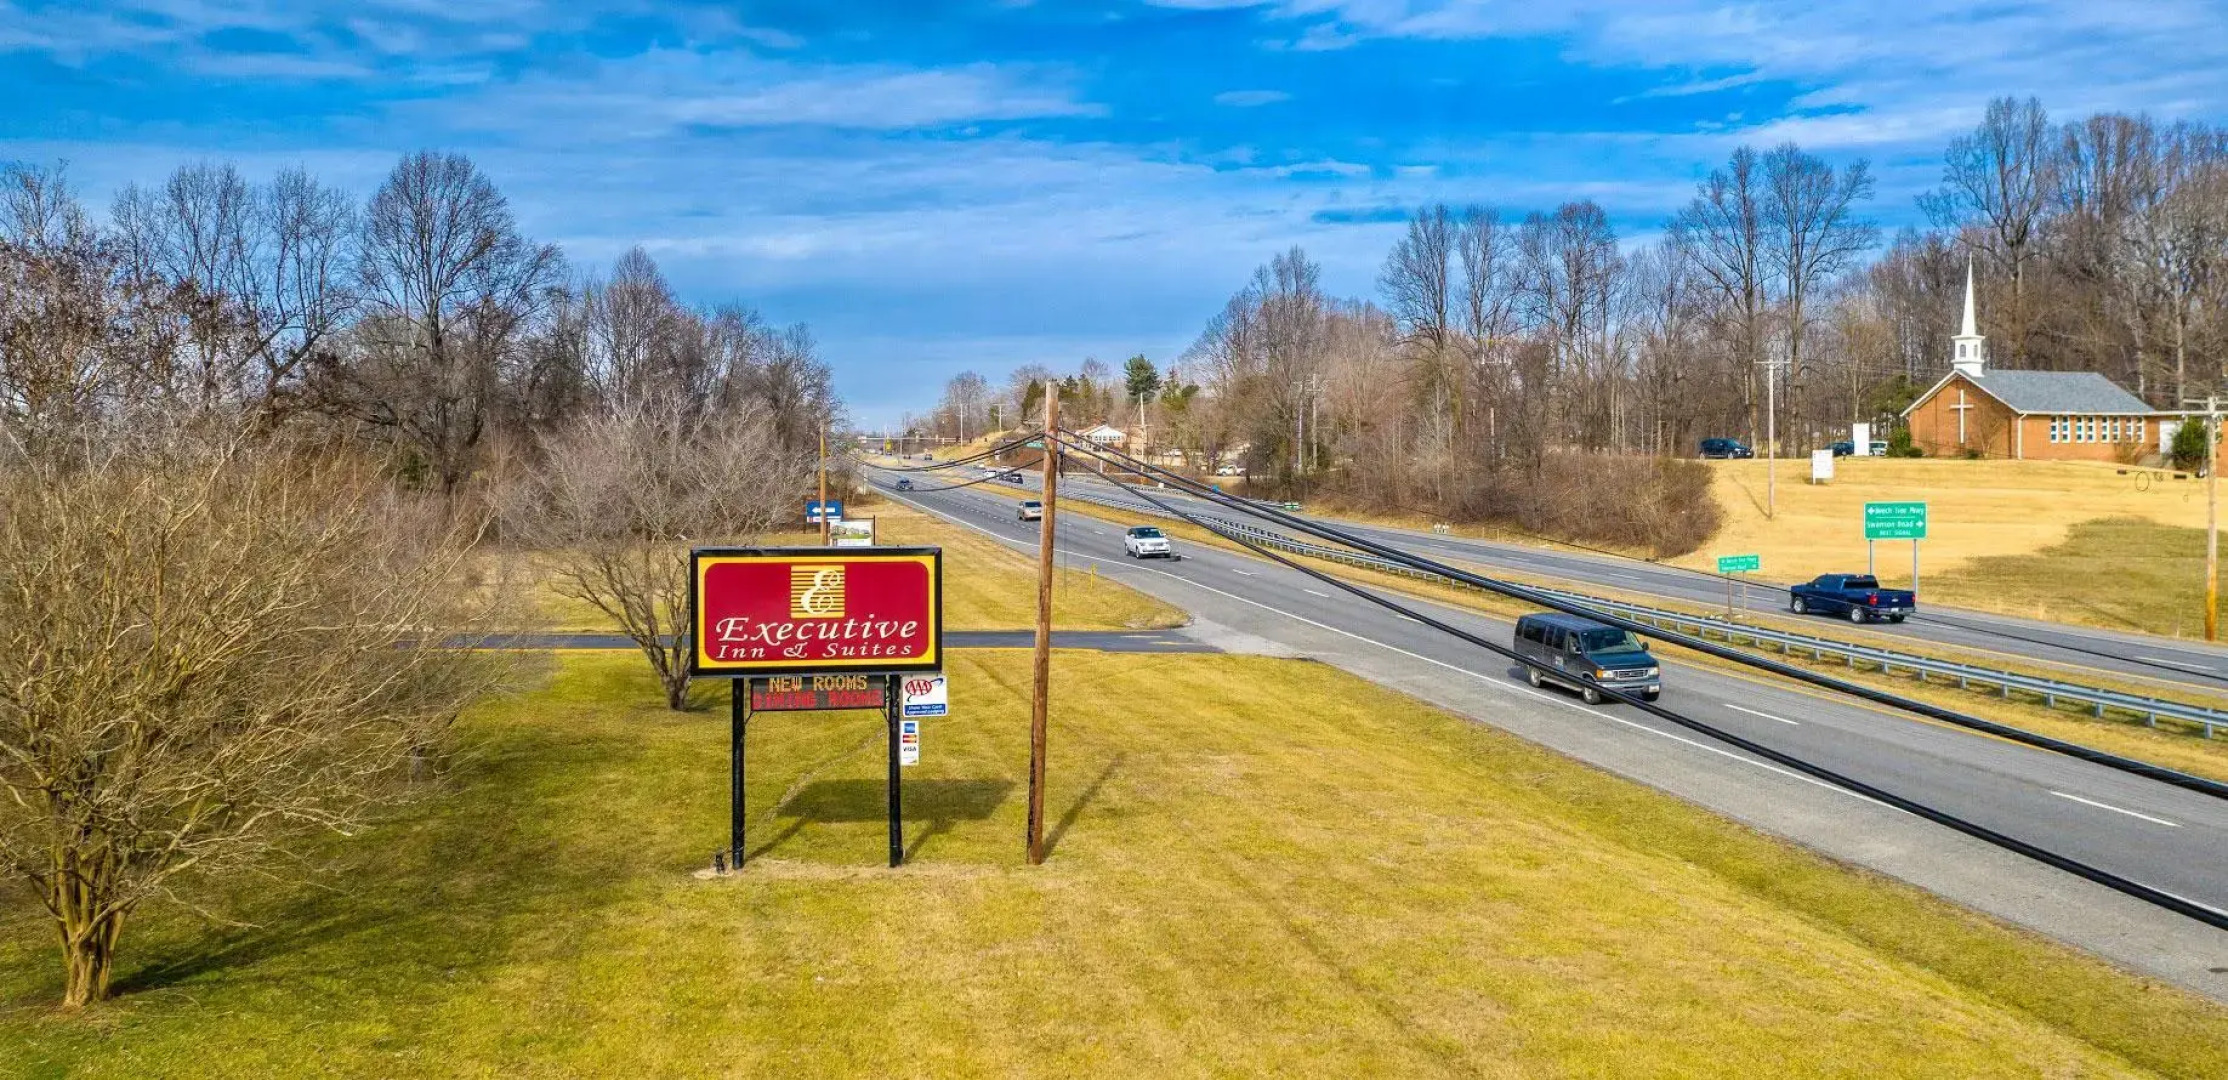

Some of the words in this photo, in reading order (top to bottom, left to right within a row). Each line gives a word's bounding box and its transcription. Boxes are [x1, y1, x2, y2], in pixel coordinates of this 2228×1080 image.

[715, 613, 918, 646] Executive
[716, 645, 766, 660] Inn
[783, 642, 808, 659] &
[822, 641, 913, 658] Suites
[770, 676, 803, 693] NEW
[813, 675, 868, 692] ROOMS
[907, 679, 930, 695] AAA
